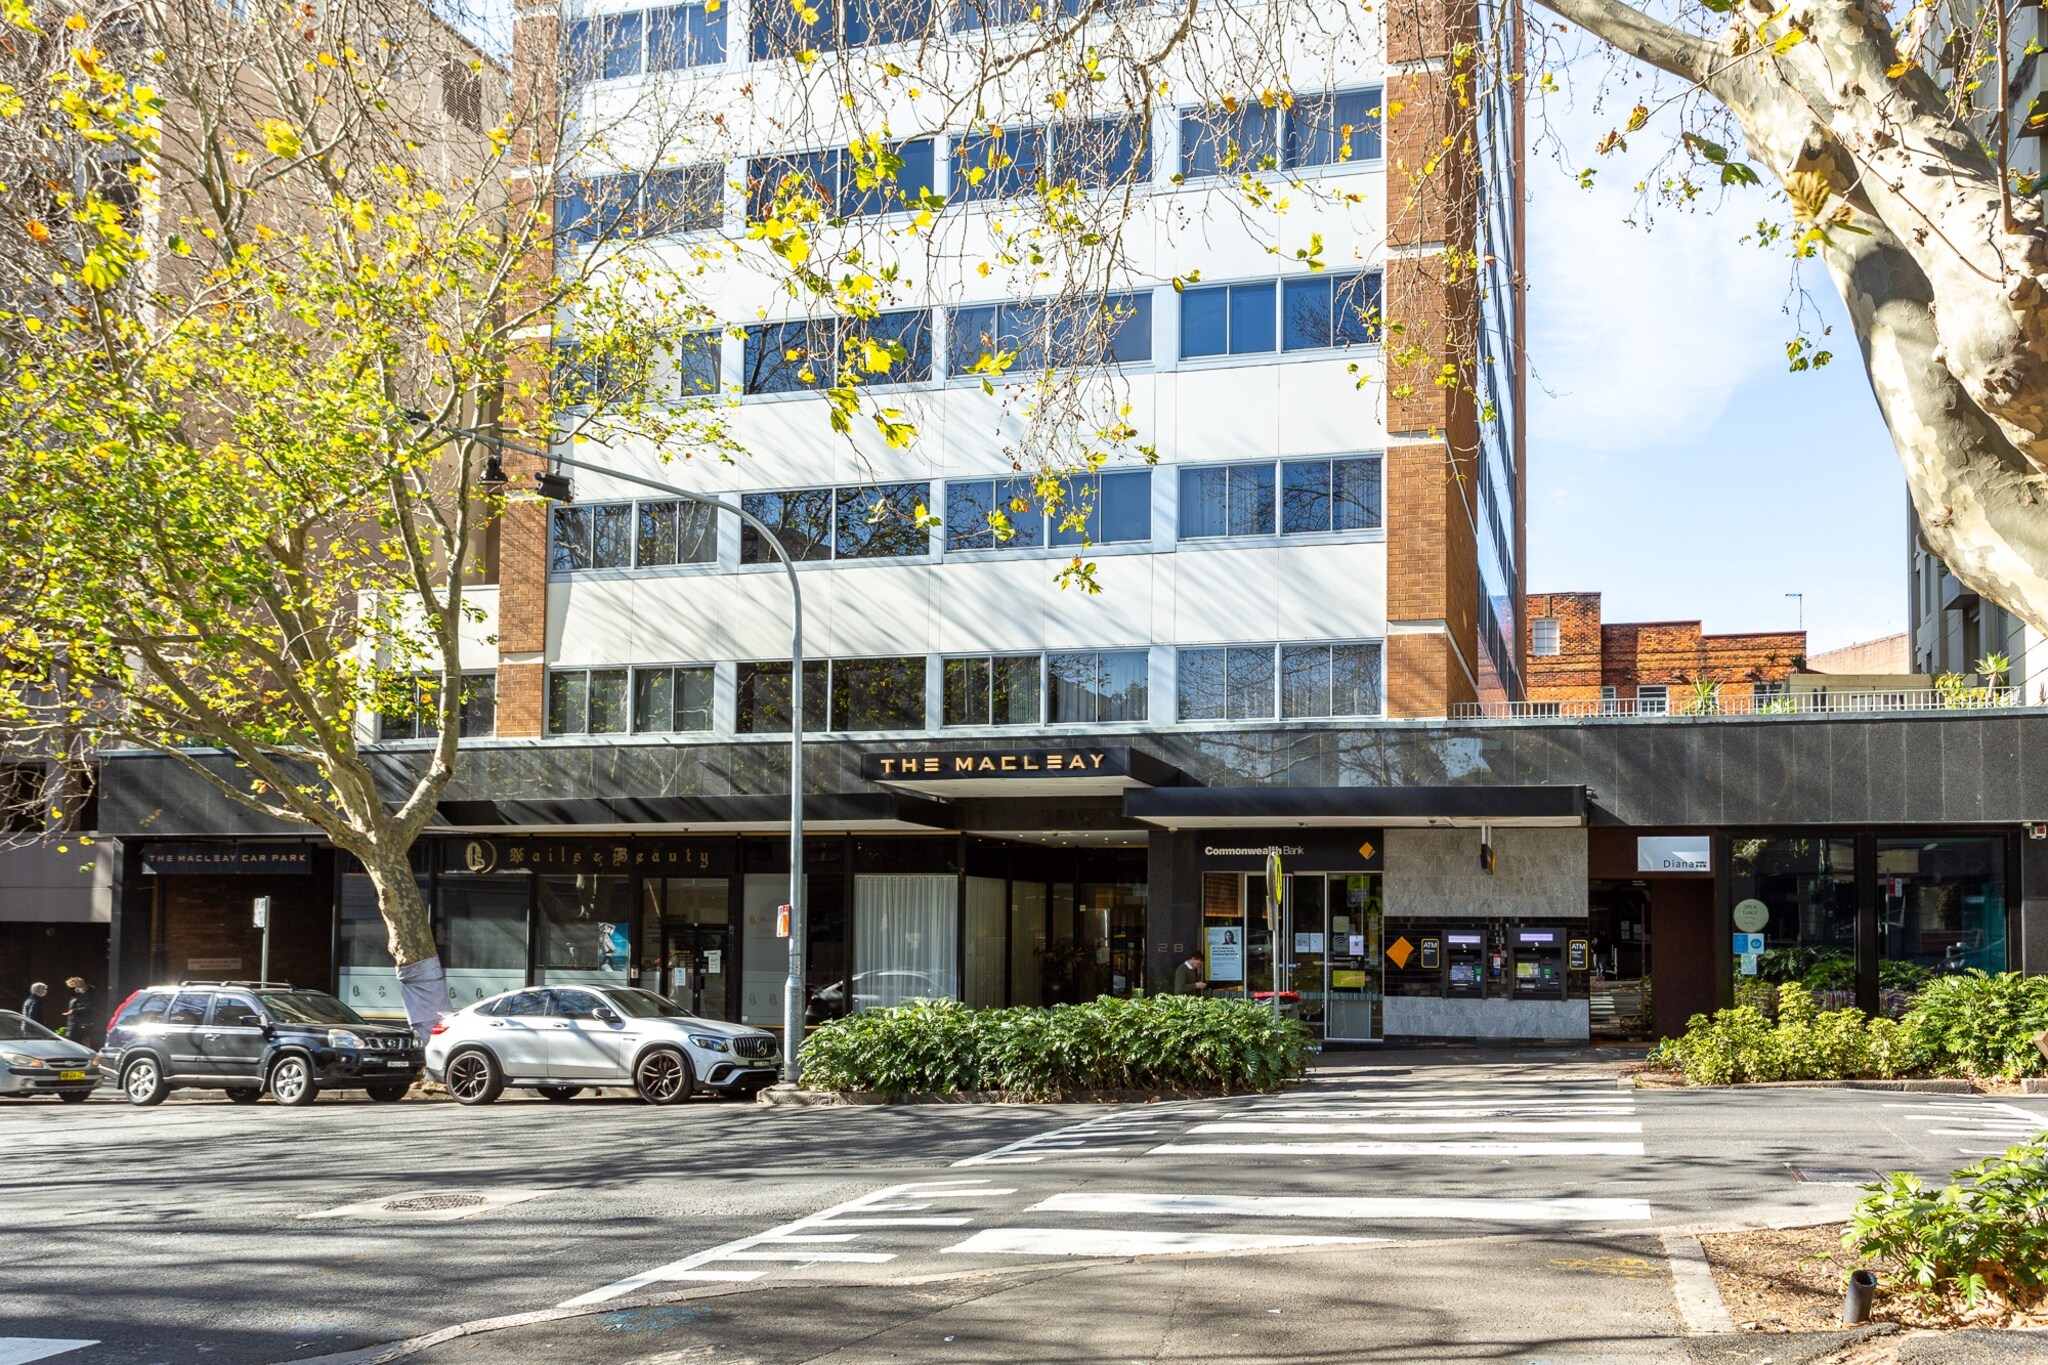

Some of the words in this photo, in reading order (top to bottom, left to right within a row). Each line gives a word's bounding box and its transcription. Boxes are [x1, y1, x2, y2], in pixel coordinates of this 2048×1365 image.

[880, 757, 940, 774] THE
[955, 754, 1105, 772] MACLEAY
[1204, 846, 1282, 856] Commonwealth
[1283, 845, 1305, 855] Bank
[150, 855, 173, 863] THE
[178, 855, 237, 863] MACLEAY
[241, 854, 267, 862] CAR
[272, 854, 306, 862] PARK
[509, 847, 582, 865] Nails
[612, 847, 710, 869] Beauty
[1663, 860, 1695, 868] Diana
